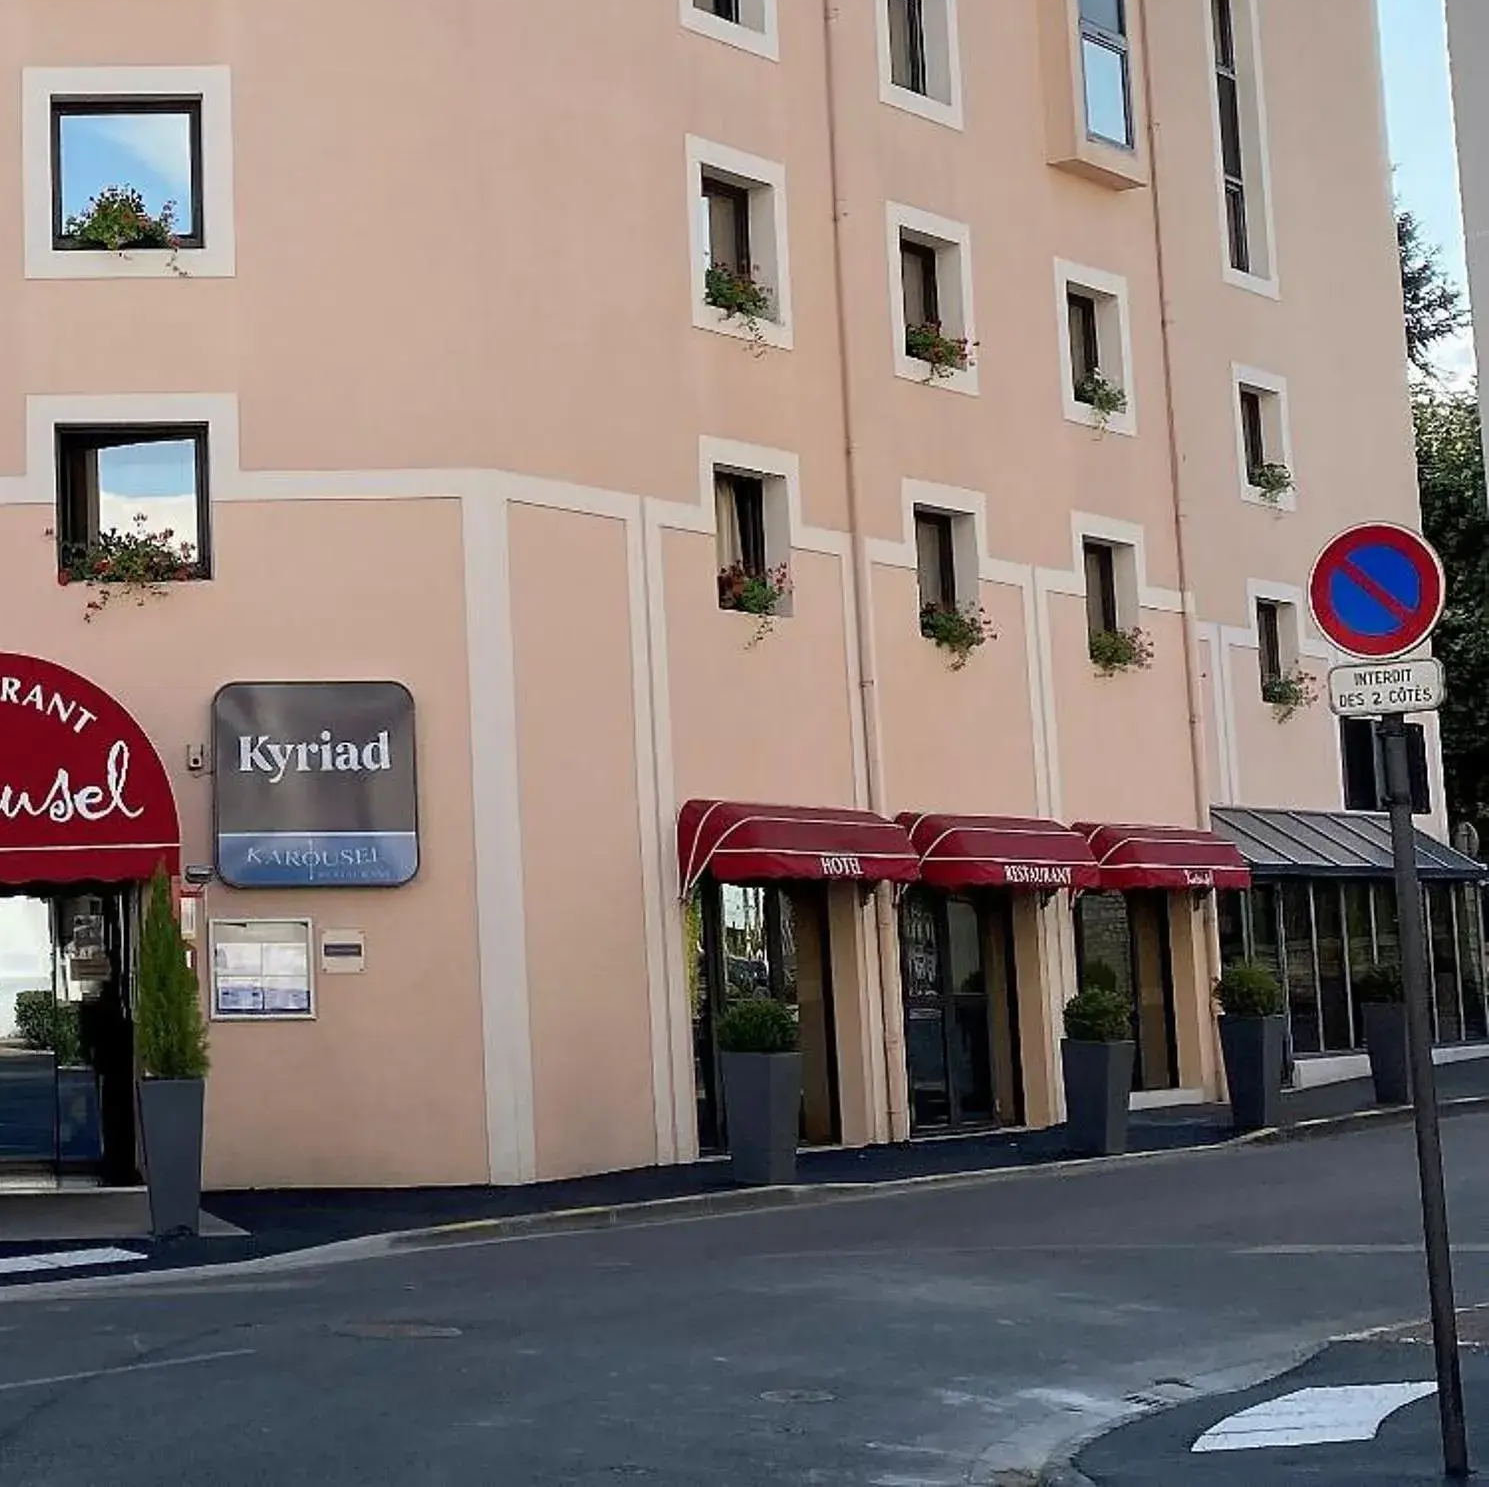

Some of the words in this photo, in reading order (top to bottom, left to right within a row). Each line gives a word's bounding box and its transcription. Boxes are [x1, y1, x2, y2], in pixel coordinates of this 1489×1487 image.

[1353, 668, 1412, 686] INTERDIT
[1339, 692, 1365, 708] DES
[1372, 691, 1383, 706] 2
[1388, 684, 1432, 704] CÔTÉS
[238, 729, 392, 784] Kyriad
[245, 845, 378, 868] KAROUSEL
[820, 856, 865, 876] HOTEL
[1004, 864, 1073, 885] RESTAURANT
